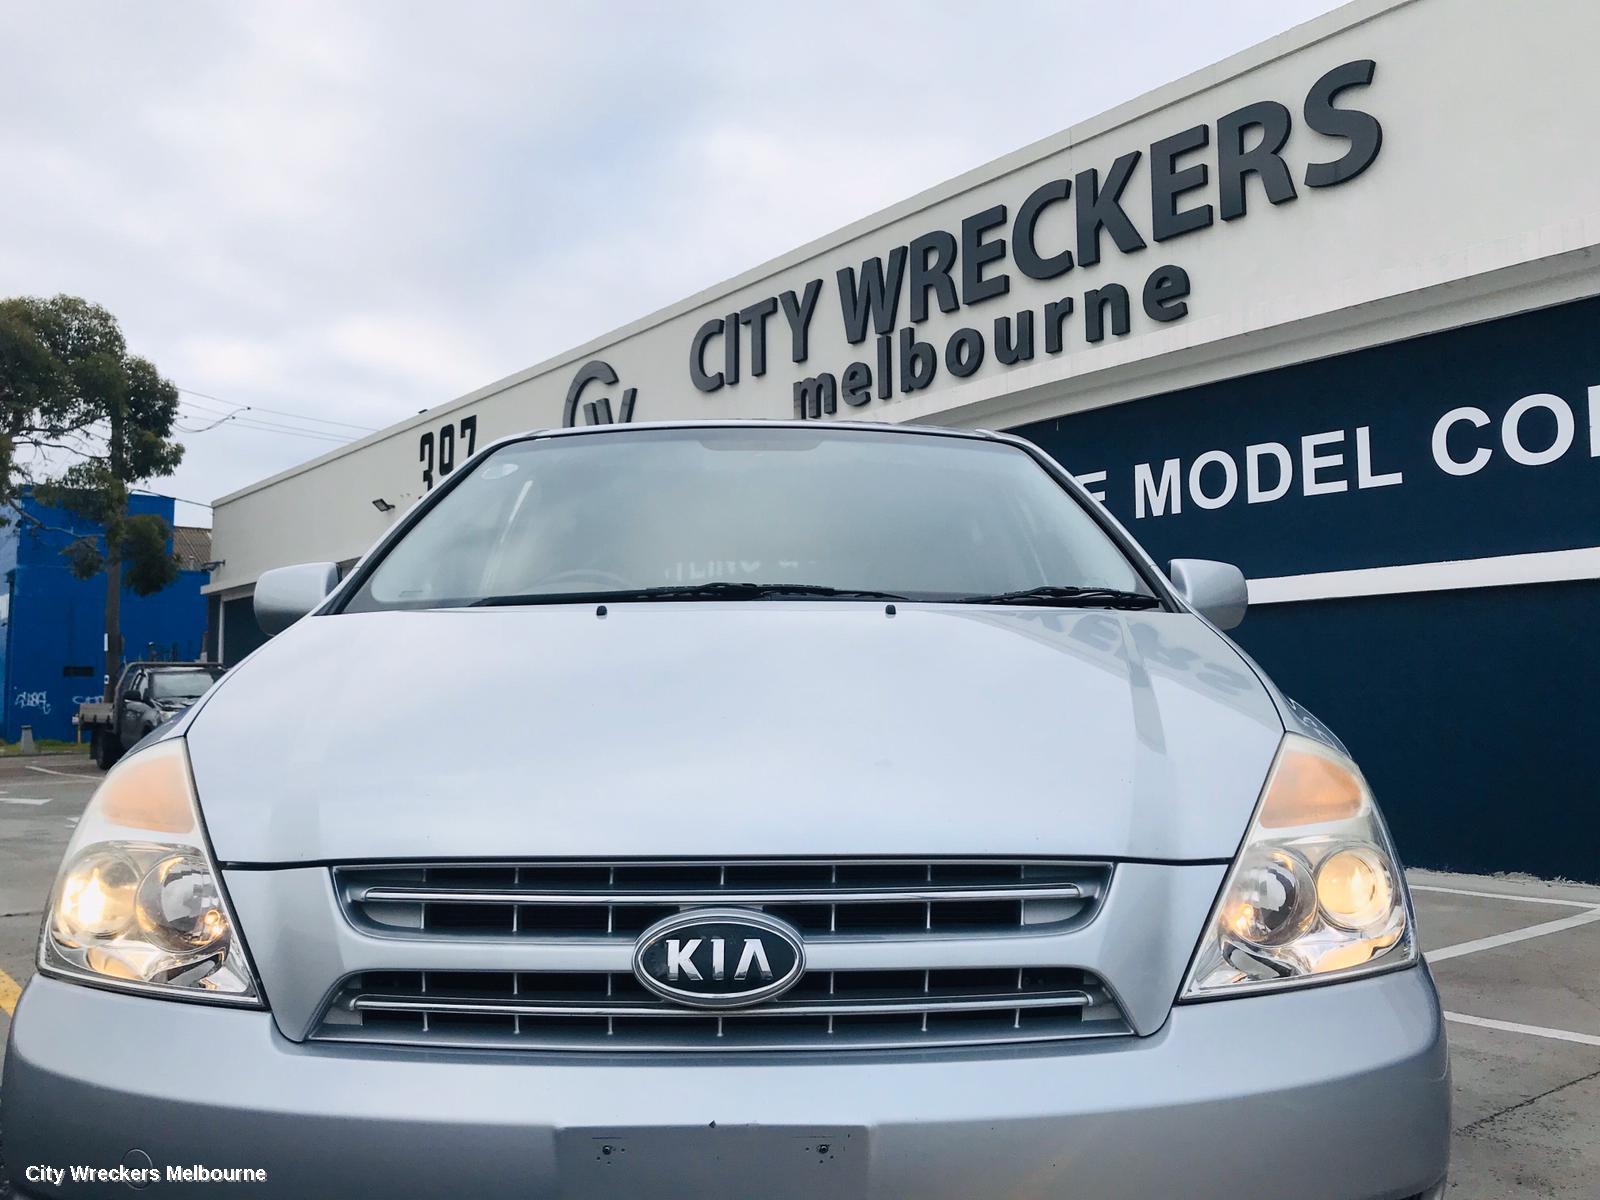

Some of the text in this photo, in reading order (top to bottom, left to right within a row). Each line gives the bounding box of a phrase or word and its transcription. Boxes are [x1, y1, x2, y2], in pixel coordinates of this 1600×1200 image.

[689, 59, 1384, 392] CITY WRECKERS
[793, 264, 1191, 420] melbourne
[418, 414, 477, 499] 307
[1134, 426, 1403, 519] MODEL
[666, 938, 773, 981] KIA
